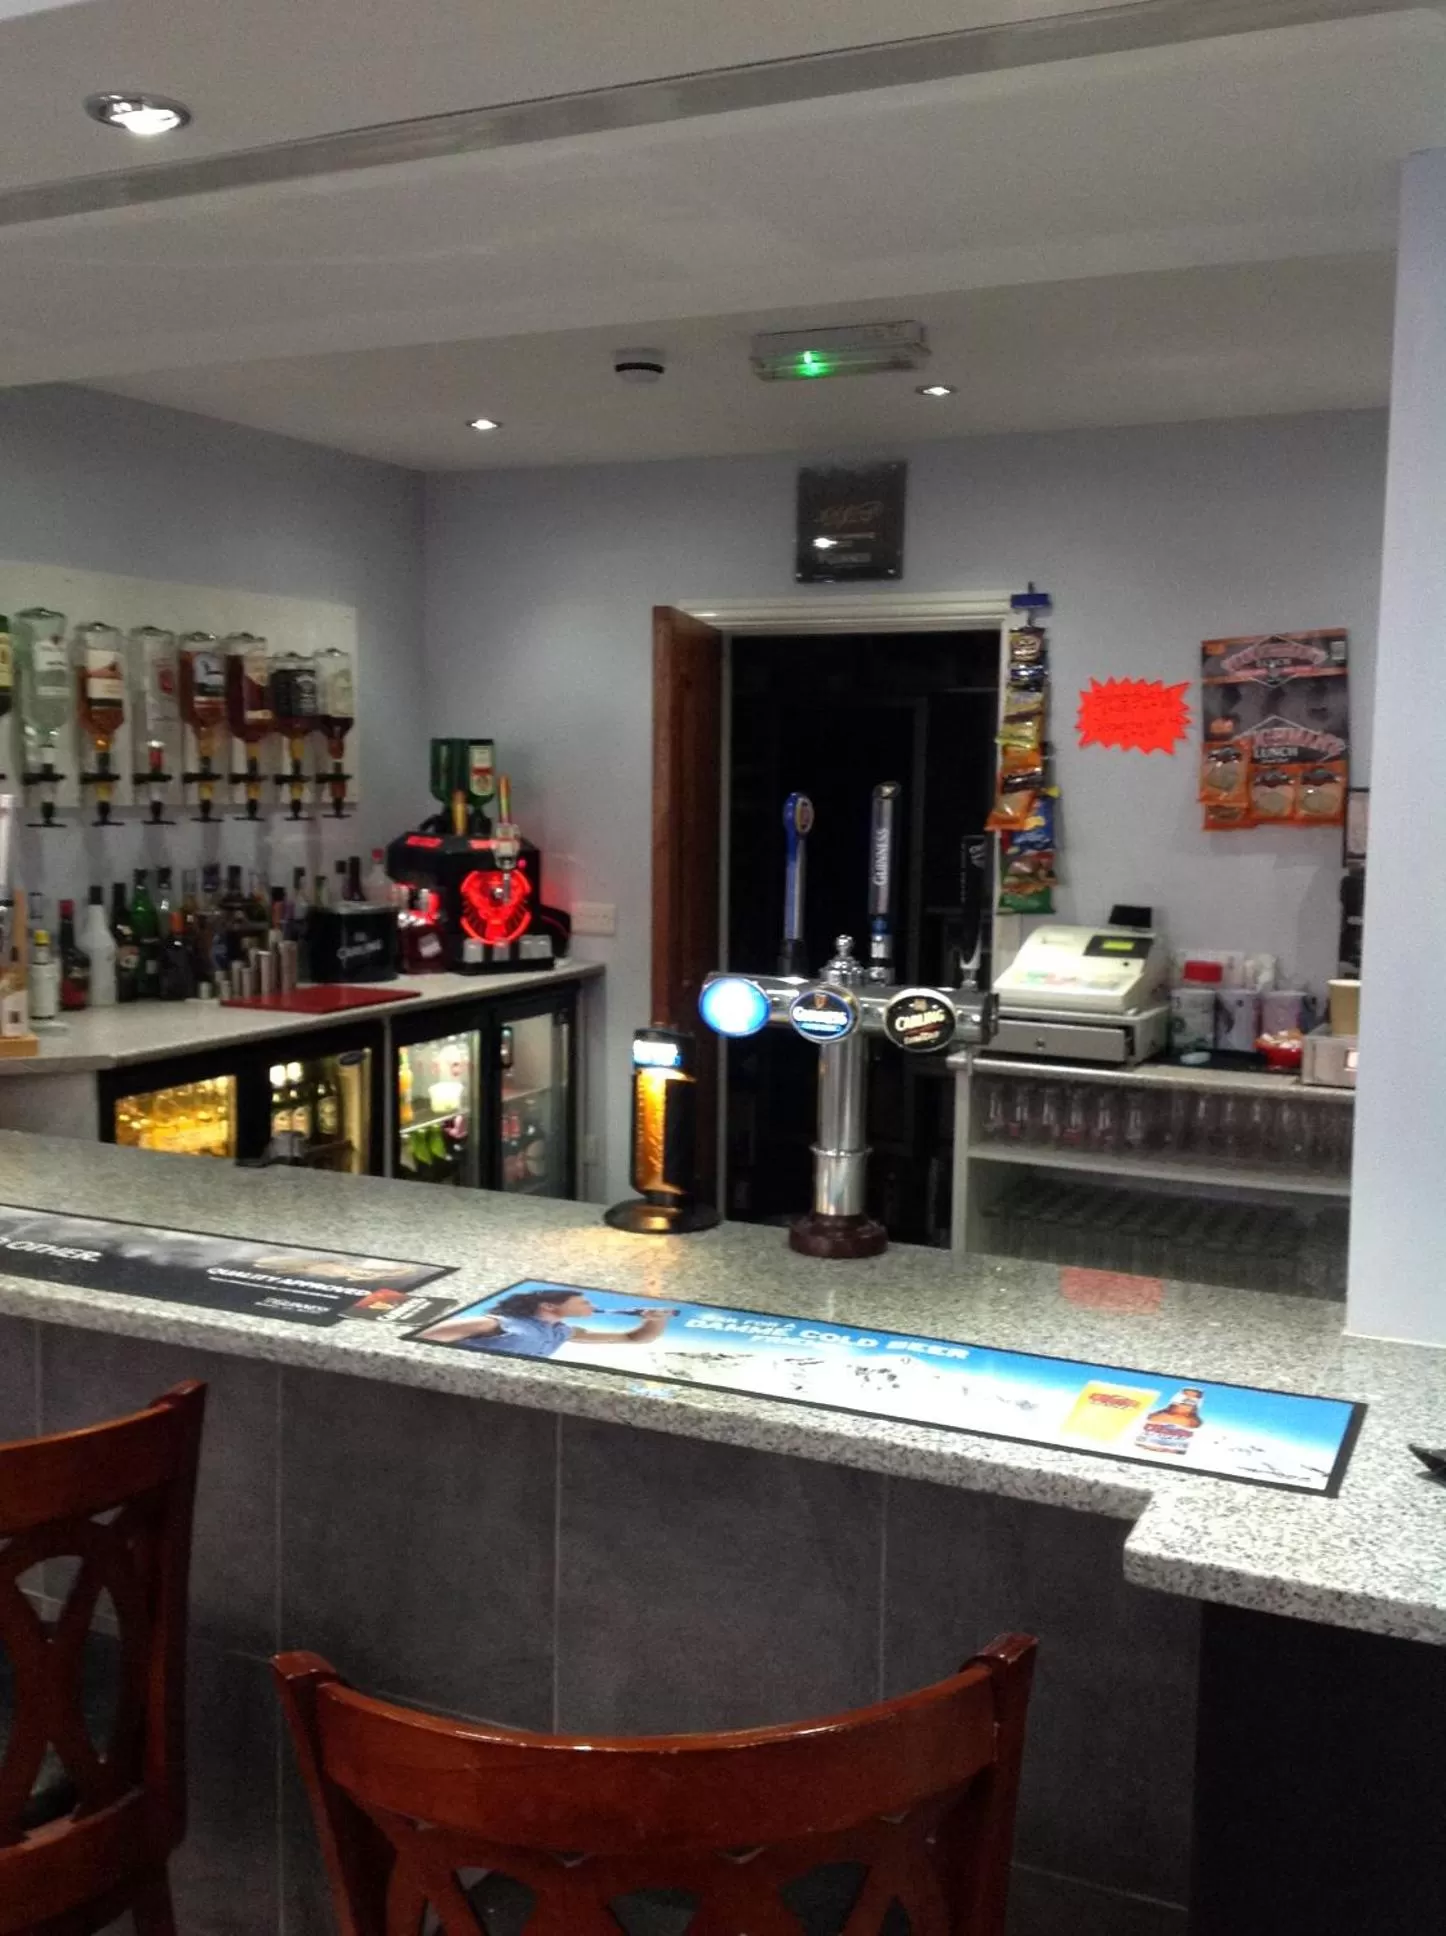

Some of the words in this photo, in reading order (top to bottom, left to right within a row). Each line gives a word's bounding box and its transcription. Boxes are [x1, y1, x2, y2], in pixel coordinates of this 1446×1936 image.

[1254, 746, 1298, 759] LUNCH
[873, 828, 891, 887] GUINNESS
[5, 1240, 104, 1263] OTHER
[799, 1329, 880, 1348] COLD
[886, 1340, 970, 1360] BEER
